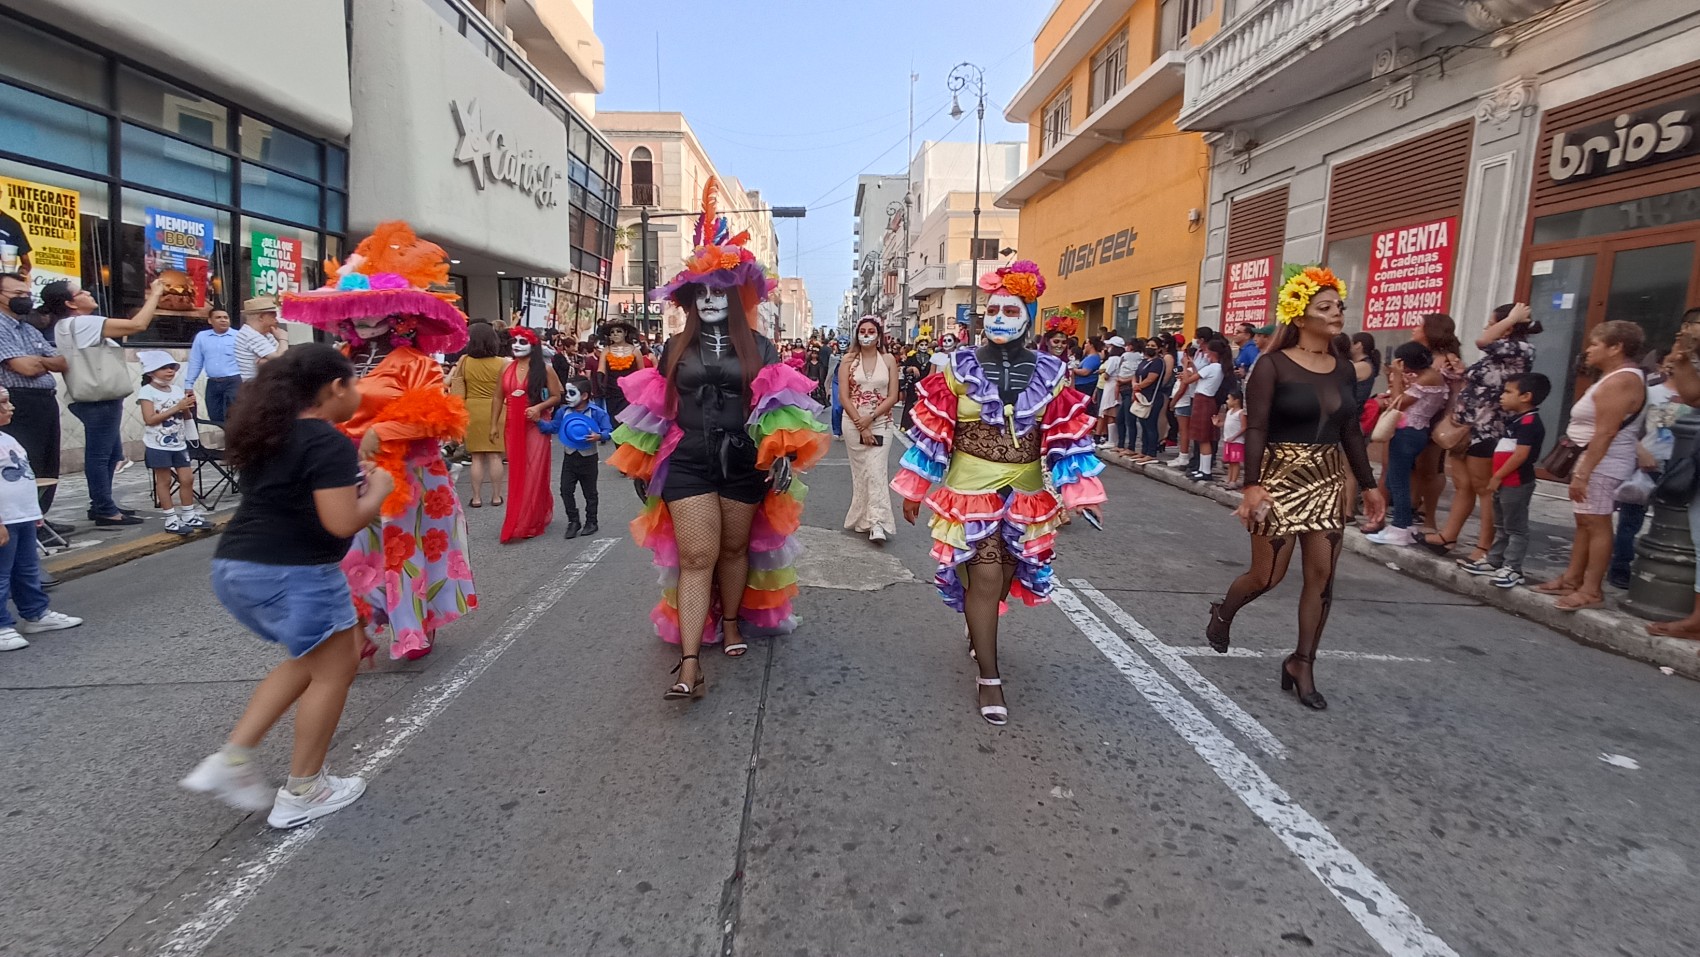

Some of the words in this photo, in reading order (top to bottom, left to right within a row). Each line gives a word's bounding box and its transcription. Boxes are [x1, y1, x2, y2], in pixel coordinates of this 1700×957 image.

[1549, 110, 1689, 181] brios
[7, 183, 76, 208] ¡INTEGRATE
[9, 198, 17, 210] A
[19, 199, 34, 212] UN
[37, 202, 76, 219] EQUIPO
[21, 212, 40, 225] CON
[42, 215, 76, 230] MUCHA
[155, 214, 205, 237] MEMPHIS
[164, 230, 198, 250] BBQ
[1375, 232, 1395, 259] SE
[1396, 221, 1448, 255] RENTA
[1229, 263, 1242, 282] SE
[1242, 258, 1270, 280] RENTA
[1380, 257, 1388, 270] A
[1390, 251, 1439, 268] cadenas
[1374, 262, 1443, 281] comerciales
[1229, 286, 1267, 299] comerciales
[1232, 281, 1238, 291] A
[1238, 279, 1265, 290] cadenas
[1371, 285, 1378, 294] o
[1380, 276, 1443, 293] franquicias
[1232, 298, 1267, 309] franquicias
[1385, 295, 1401, 311] 229
[1402, 291, 1442, 310] 9841901
[1383, 312, 1399, 328] 229
